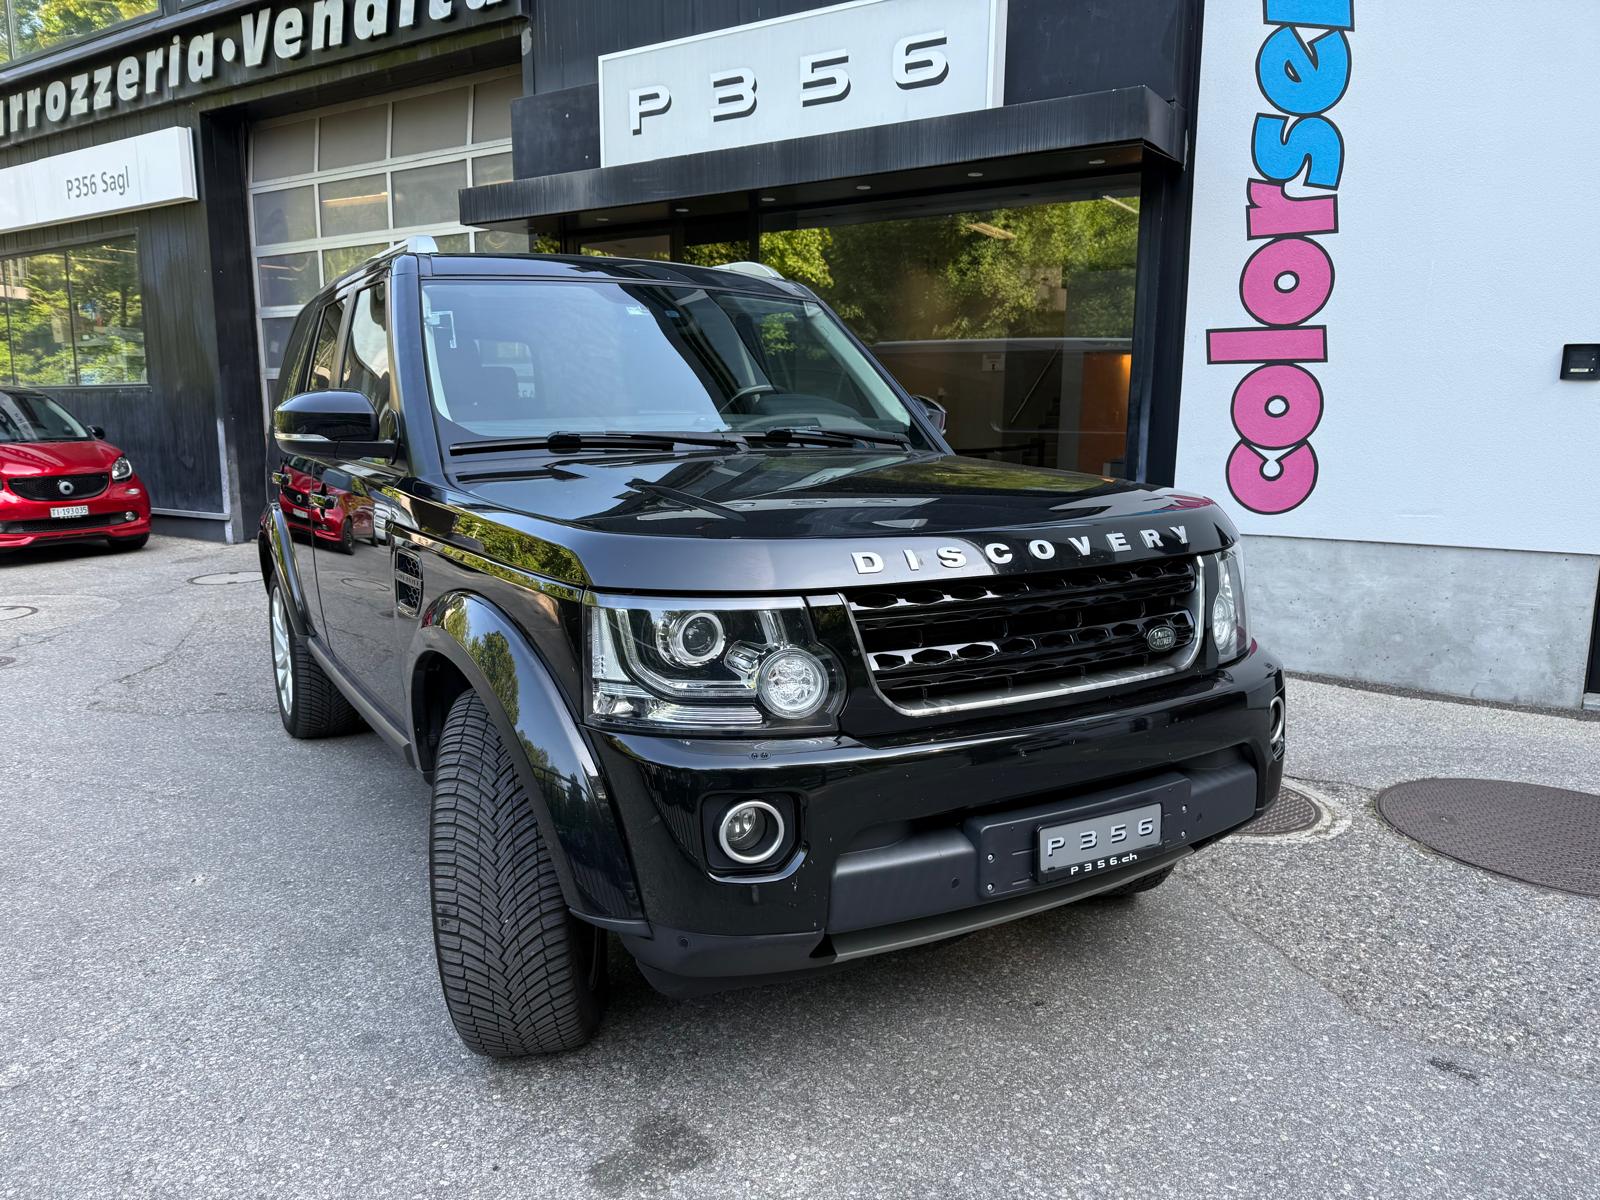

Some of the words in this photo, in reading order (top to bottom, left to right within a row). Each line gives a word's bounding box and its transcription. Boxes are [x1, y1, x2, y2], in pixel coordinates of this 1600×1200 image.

[0, 32, 213, 136] rrozzeria
[629, 30, 949, 137] P356
[66, 173, 97, 200] P356
[100, 165, 130, 196] Sagl
[850, 525, 1190, 575] DISCOVERY
[1047, 817, 1153, 857] P356
[1070, 853, 1138, 876] P356.ch
